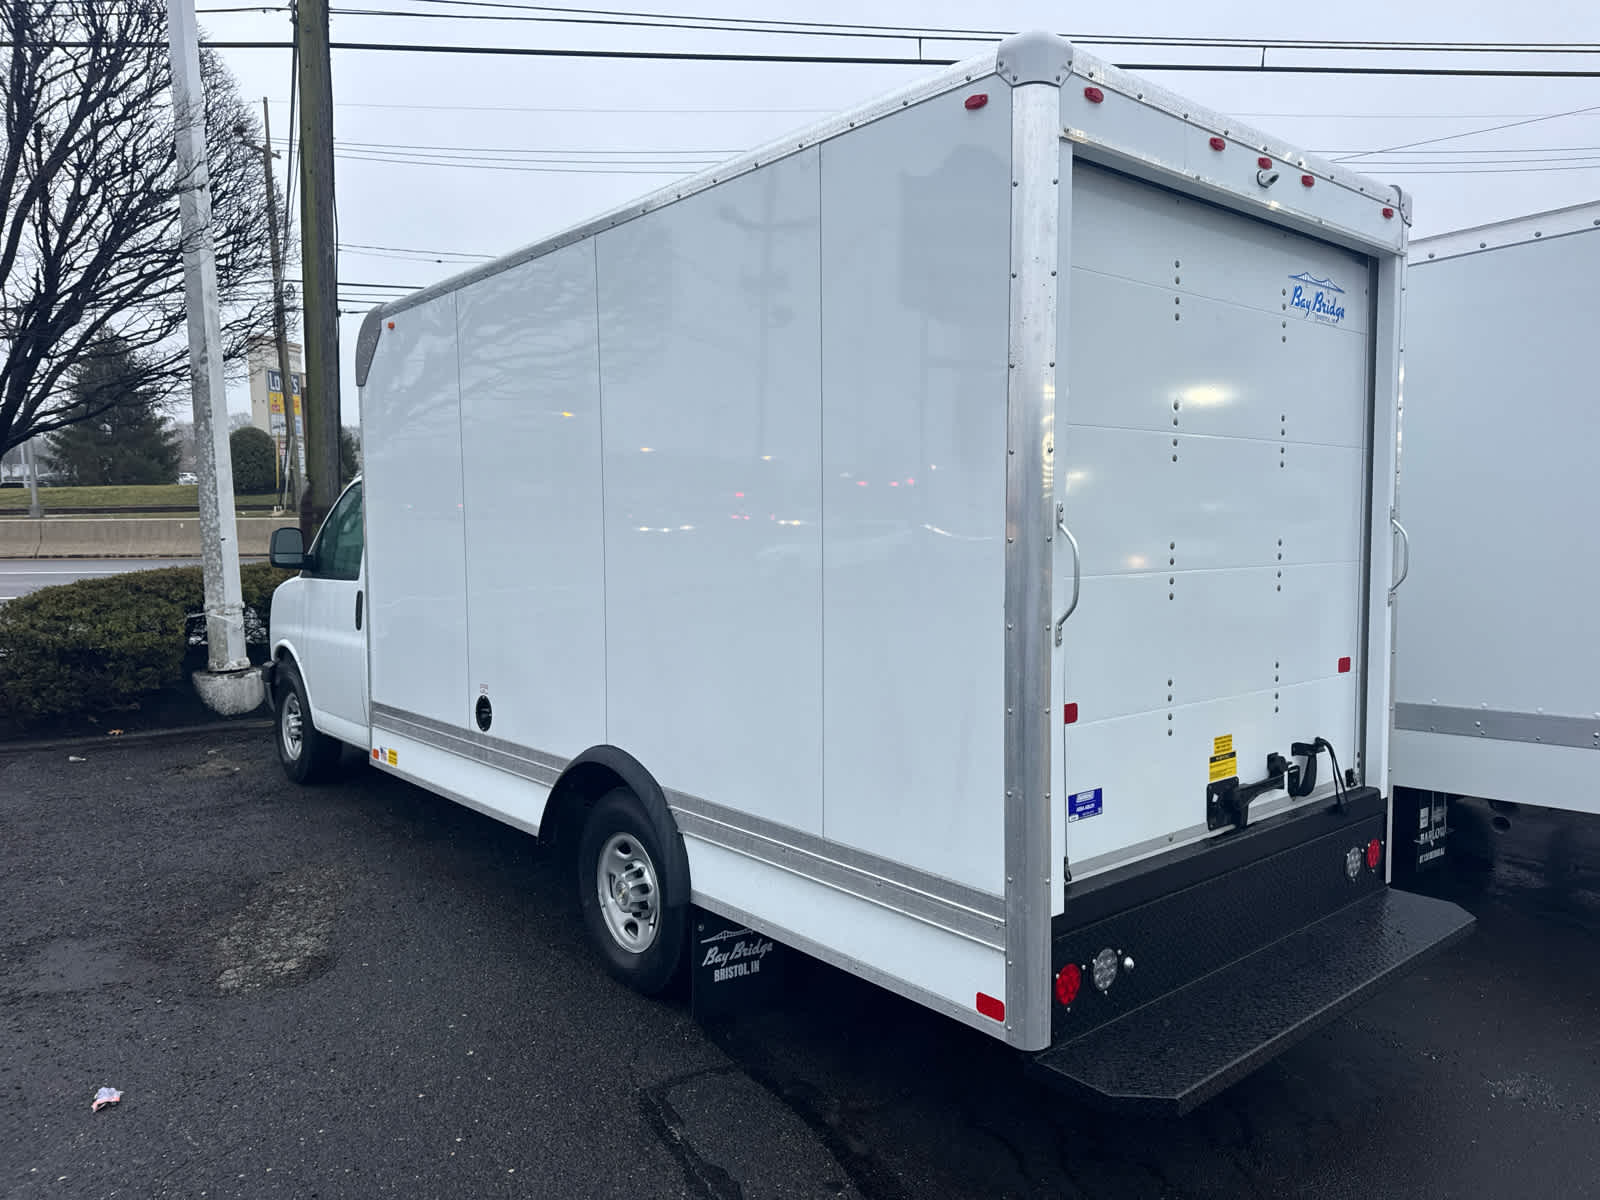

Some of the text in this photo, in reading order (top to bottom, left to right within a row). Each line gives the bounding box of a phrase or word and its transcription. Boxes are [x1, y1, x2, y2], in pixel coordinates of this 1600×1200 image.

[1290, 285, 1345, 323] Bay Bridge
[269, 371, 299, 394] LO'S
[702, 938, 773, 967] Bay Bridge
